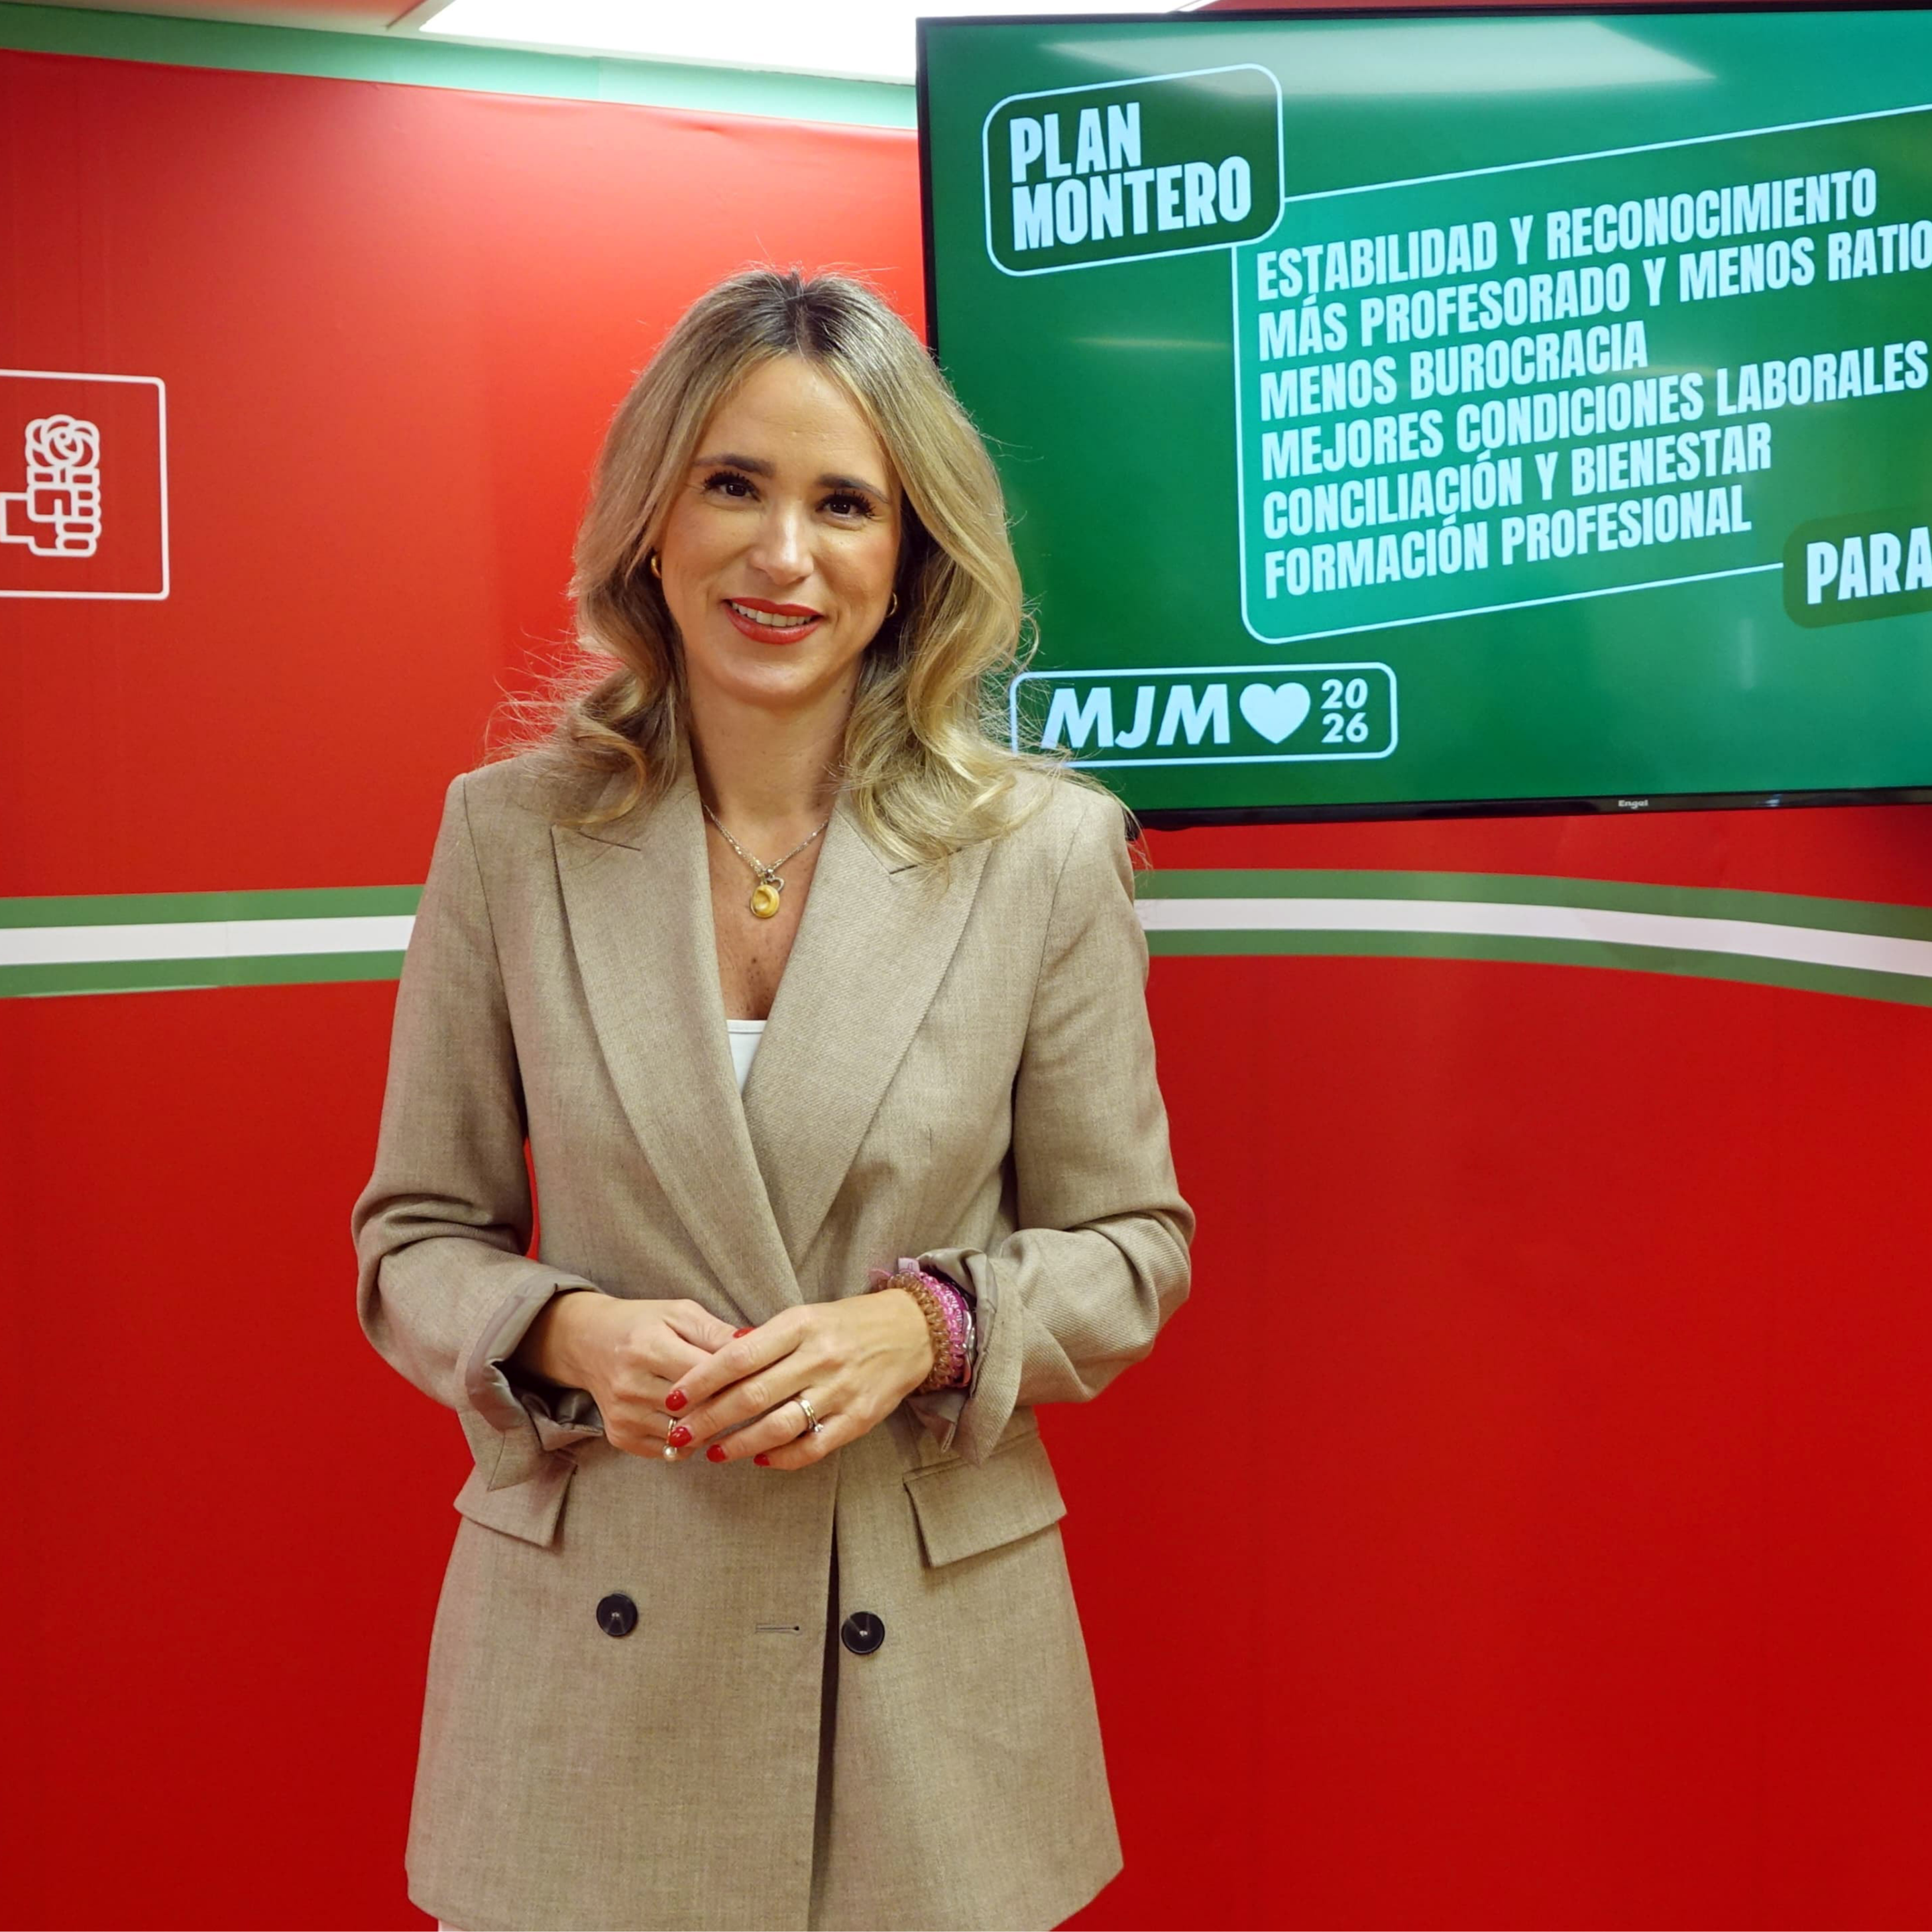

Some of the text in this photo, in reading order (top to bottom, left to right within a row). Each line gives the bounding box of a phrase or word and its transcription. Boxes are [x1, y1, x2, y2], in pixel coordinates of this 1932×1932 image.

[1010, 102, 1141, 183] PLAN
[1013, 156, 1251, 251] MONTERO
[1257, 168, 1876, 300] ESTABILIDAD Y RECONOCIMIENTO
[1259, 220, 1932, 361] MÁS PROFESORADO Y MENOS RATIO
[1260, 321, 1649, 421] MENOS BUROCRACIA
[1262, 340, 1928, 480] MEJORES CONDICIONES LABORALES
[1263, 422, 1772, 539] CONCILIACIÓN Y BIENESTAR
[1265, 484, 1752, 599] FORMACIÓN PROFESIONAL
[1807, 526, 1932, 605] PARA
[1039, 684, 1230, 750] MJM
[1321, 678, 1367, 709] 20
[1322, 712, 1368, 742] 26
